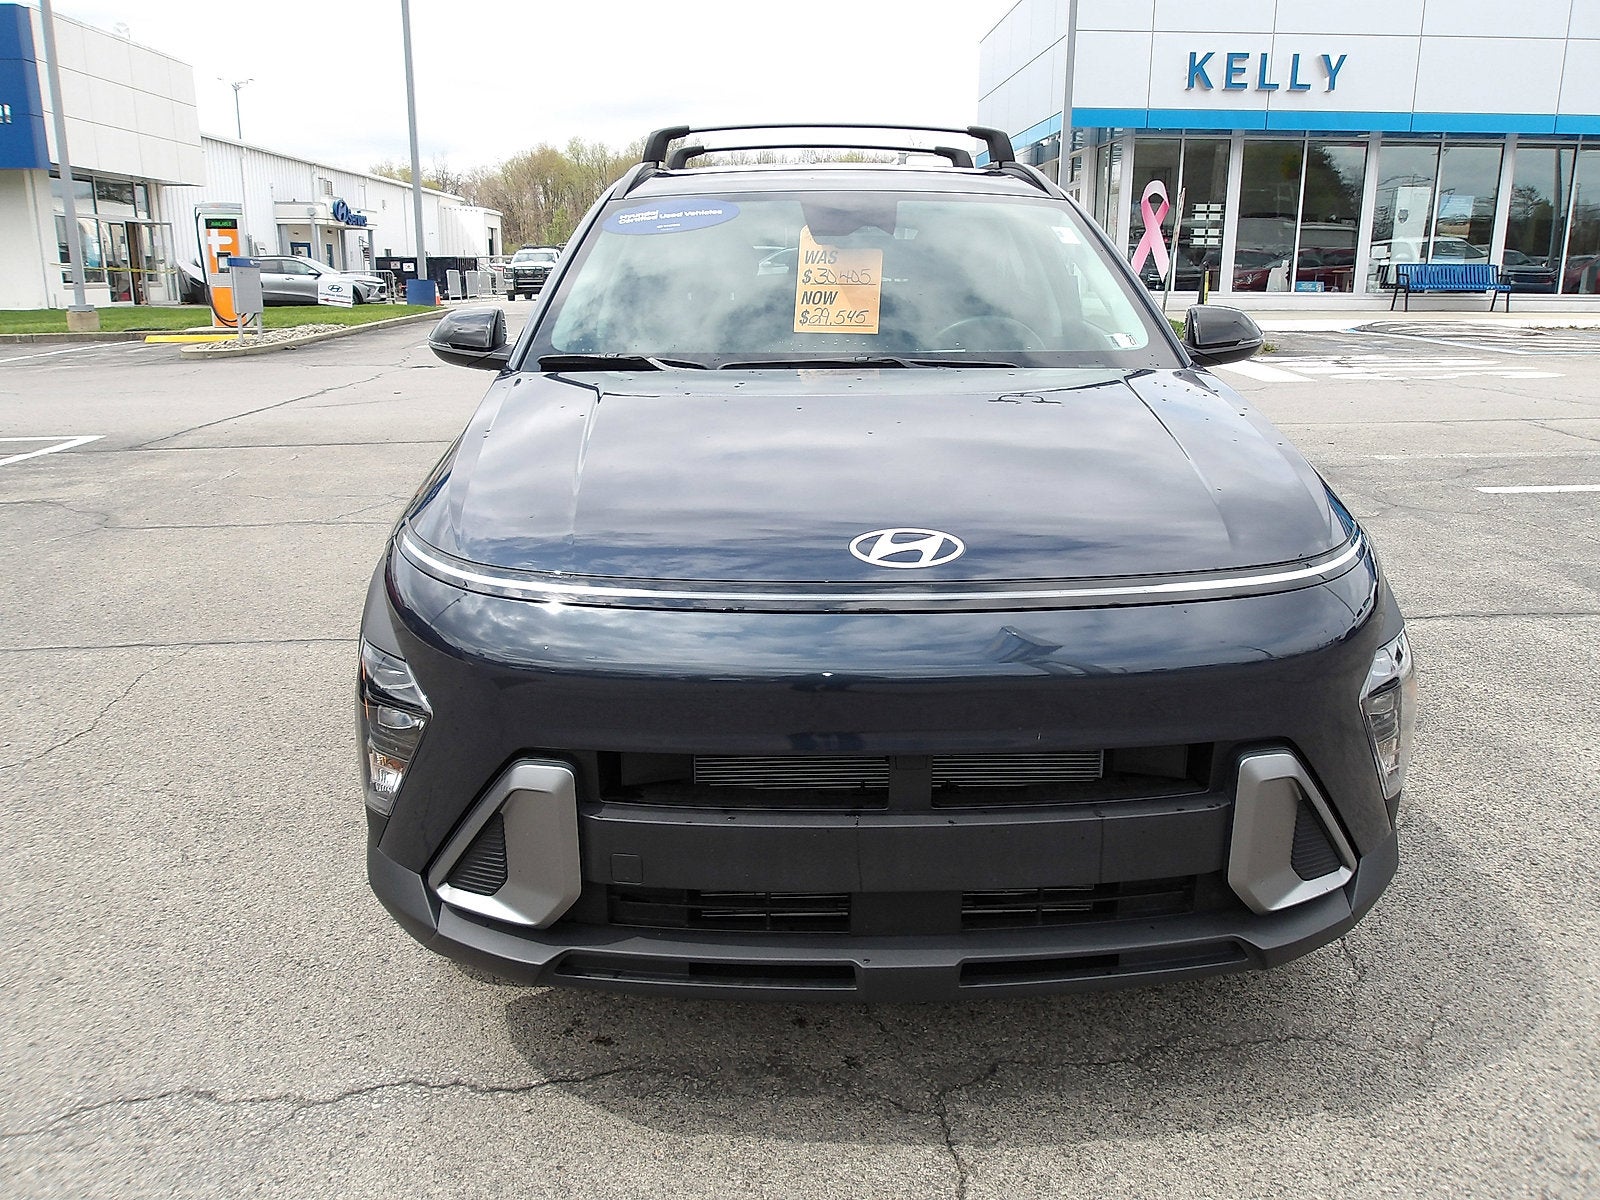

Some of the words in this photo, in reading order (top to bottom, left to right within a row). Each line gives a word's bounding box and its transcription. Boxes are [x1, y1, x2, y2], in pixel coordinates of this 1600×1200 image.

[1185, 51, 1347, 93] KELLY
[683, 209, 723, 217] Vehicles
[804, 249, 838, 265] WAS
[800, 290, 839, 306] NOW
